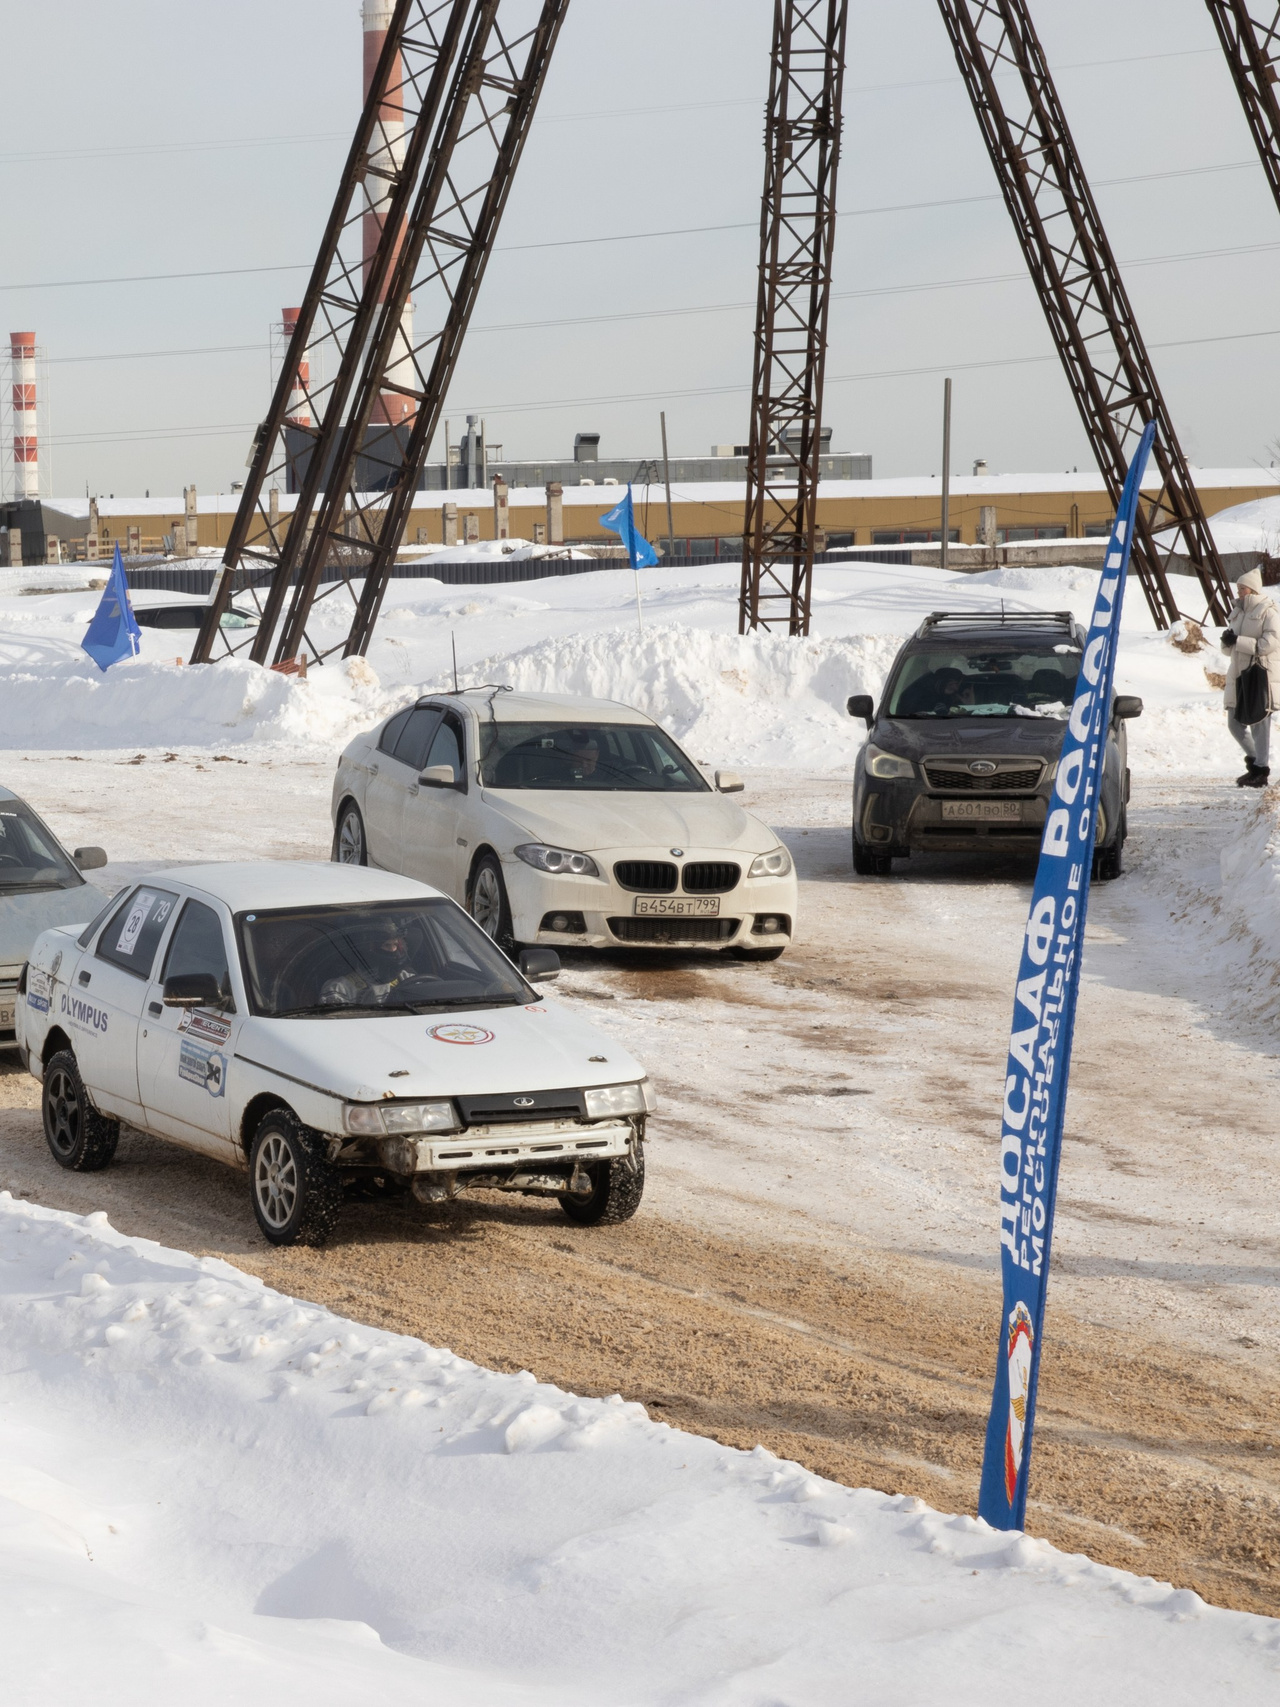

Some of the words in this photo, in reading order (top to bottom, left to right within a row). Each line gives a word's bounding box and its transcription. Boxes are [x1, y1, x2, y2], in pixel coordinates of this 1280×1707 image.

[947, 803, 1000, 815] А601ВО
[1003, 803, 1016, 813] 50
[152, 900, 171, 923] 79
[640, 899, 693, 914] В454ВТ
[696, 899, 716, 910] 799
[127, 915, 140, 934] 28
[61, 994, 108, 1032] OLYMPUS
[1020, 863, 1081, 1270] РЕГИОНАЛЬНОЕ
[1001, 896, 1056, 1265] ДОСААФ
